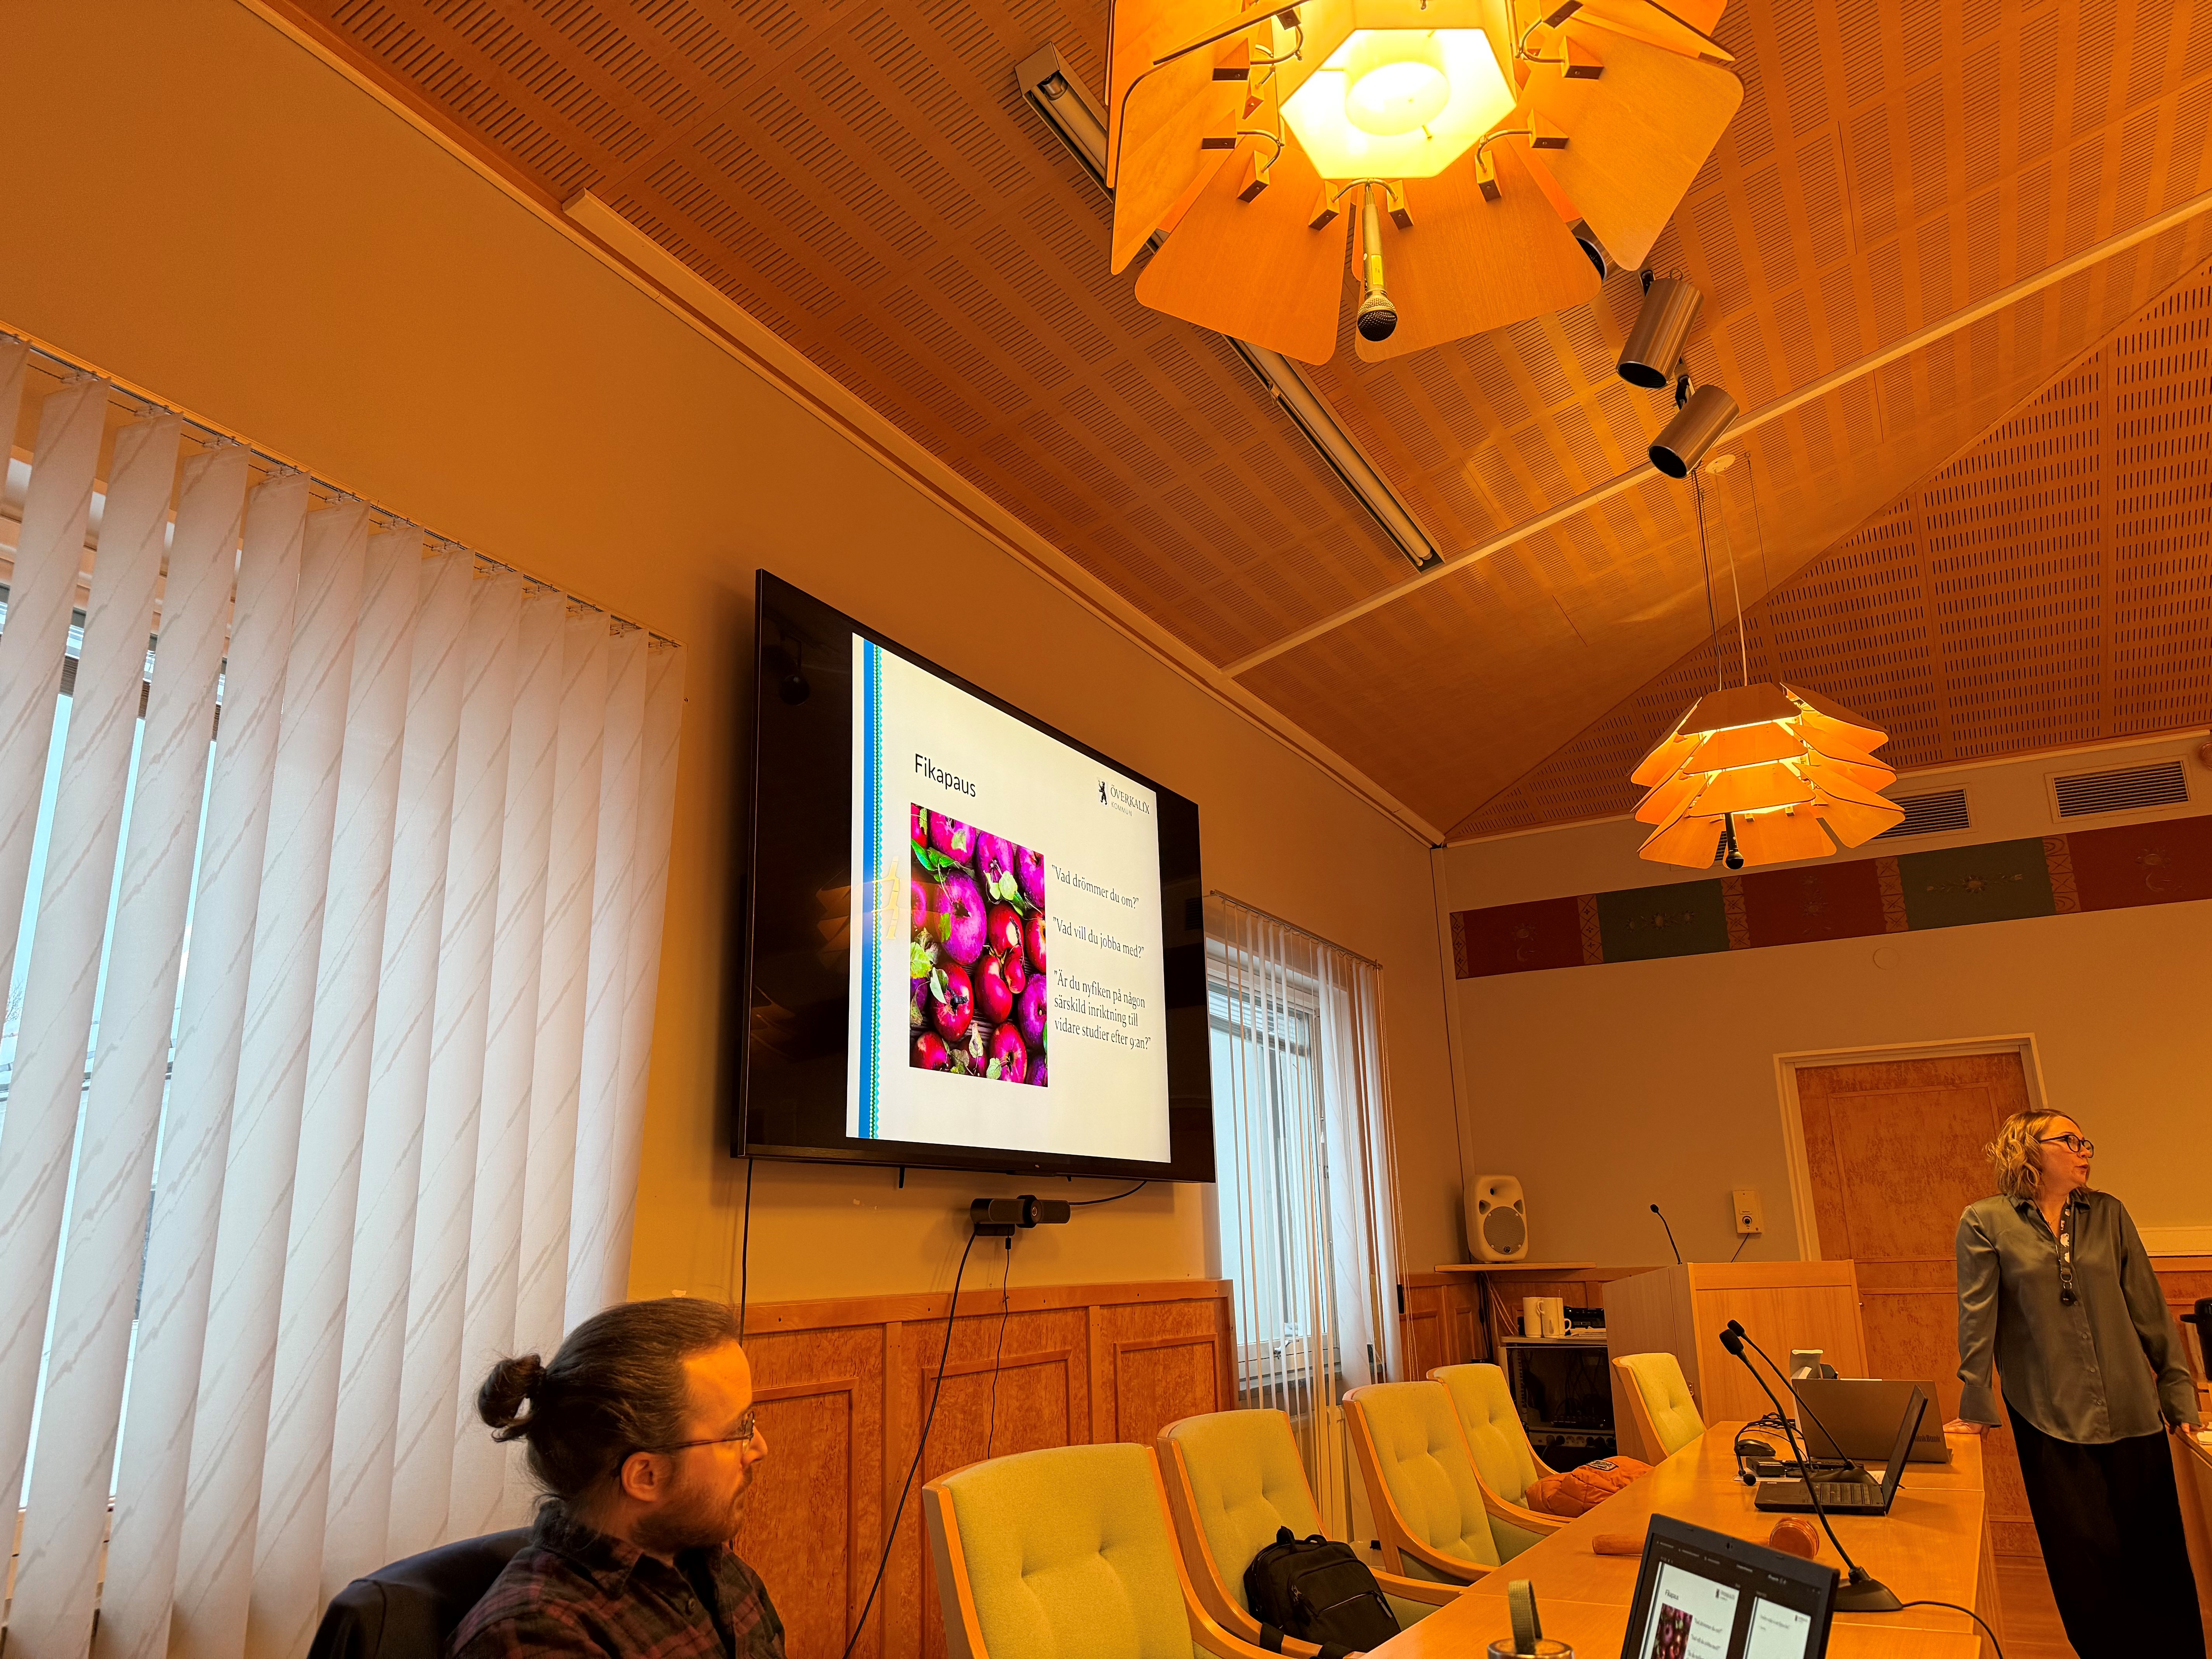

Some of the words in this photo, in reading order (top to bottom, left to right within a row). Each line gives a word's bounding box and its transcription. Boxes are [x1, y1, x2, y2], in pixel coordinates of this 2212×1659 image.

[915, 753, 975, 797] Fikapaus
[1111, 784, 1149, 814] ÖVERKALIX
[1111, 801, 1132, 817] KOMMUN
[1073, 874, 1108, 898] drömmer
[1110, 888, 1120, 903] du
[1074, 926, 1086, 940] vill
[1088, 929, 1098, 945] du
[1100, 933, 1121, 952] jobba
[1070, 975, 1080, 991] du
[1082, 981, 1111, 999] nyfiken
[1113, 988, 1121, 1004] på
[1123, 992, 1145, 1010] någon
[1054, 994, 1086, 1014] särskild
[1088, 1002, 1127, 1027] inriktning
[1128, 1013, 1138, 1026] till
[1054, 1017, 1080, 1035] vidare
[1082, 1025, 1109, 1041] studier
[1111, 1029, 1128, 1045] efter
